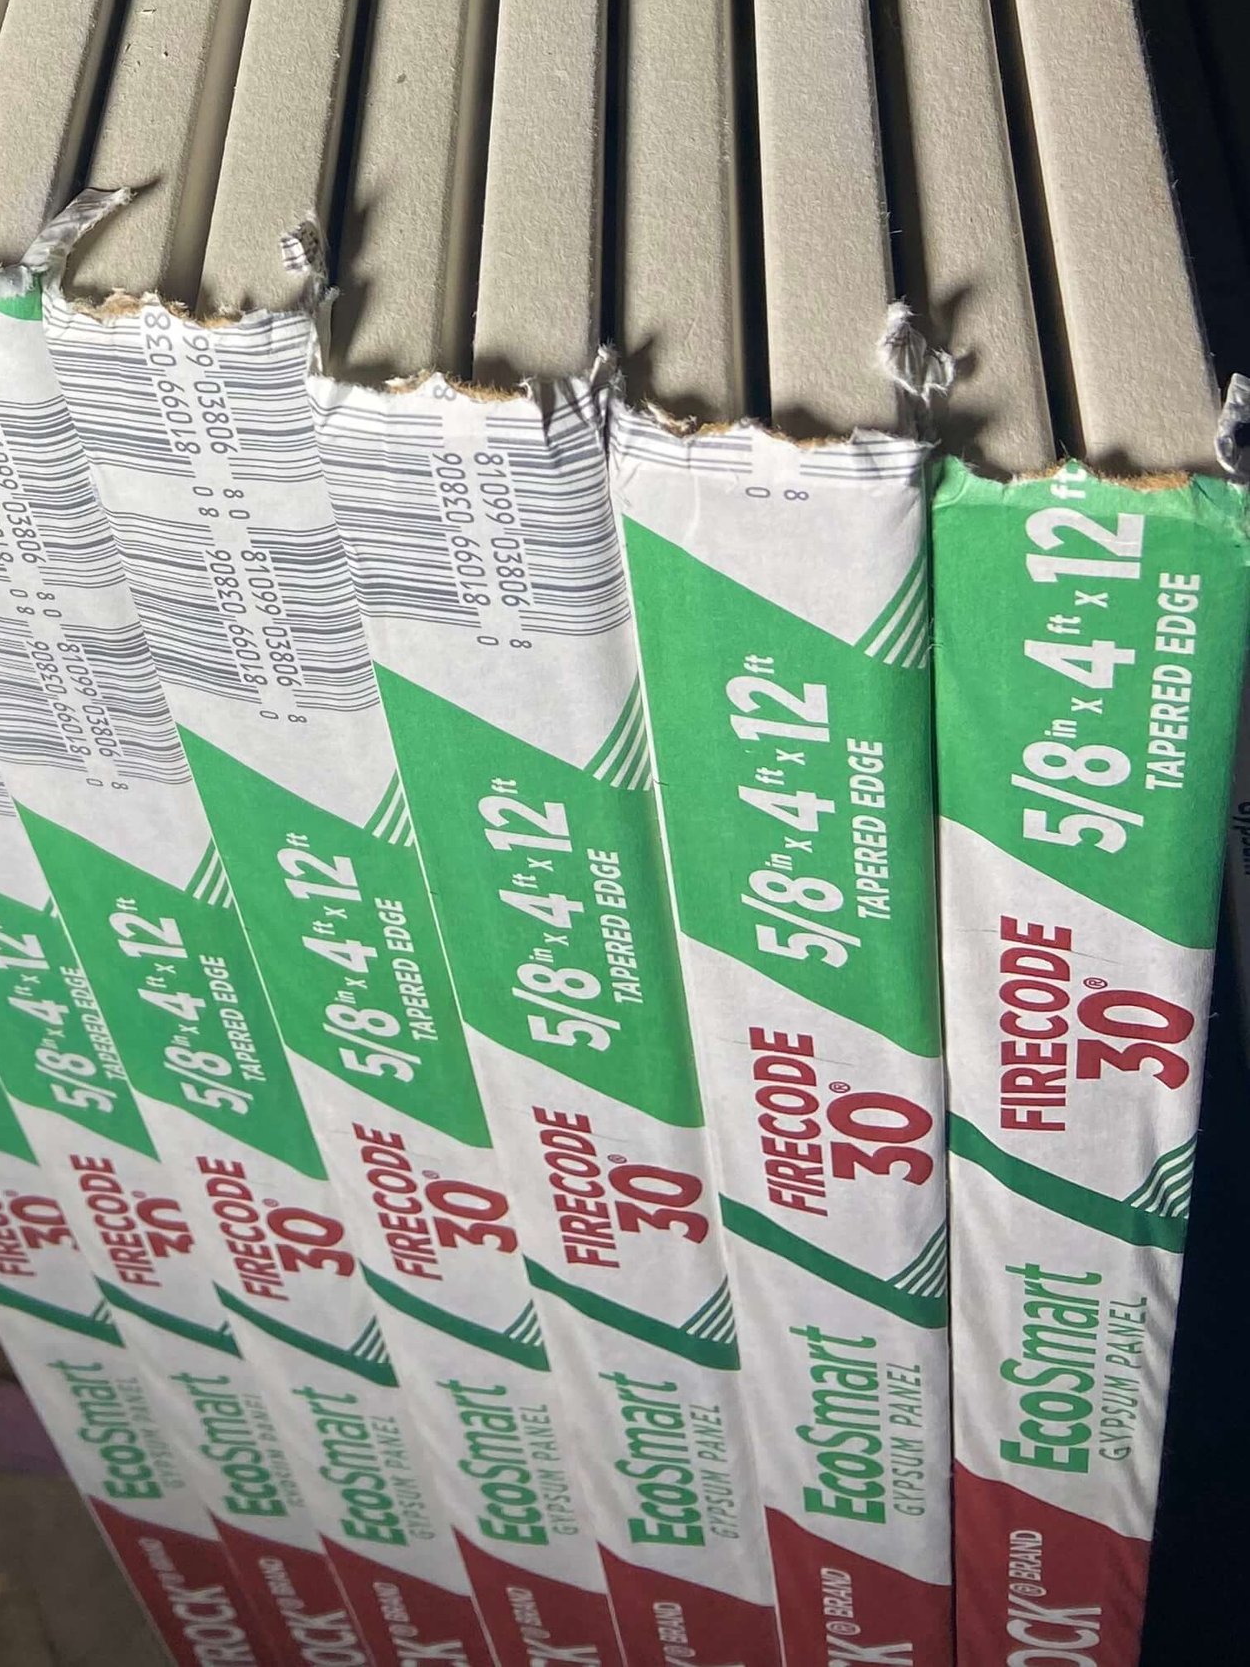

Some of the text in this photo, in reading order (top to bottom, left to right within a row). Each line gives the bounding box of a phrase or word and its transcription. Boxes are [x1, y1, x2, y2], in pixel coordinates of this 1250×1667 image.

[145, 303, 176, 367] 038
[158, 380, 200, 454] 81099
[194, 381, 238, 454] 03806
[2, 502, 47, 563] 03806
[433, 452, 474, 525] 03806
[474, 452, 515, 525] 81099
[206, 550, 246, 615] 03806
[241, 550, 281, 615] 81099
[262, 626, 302, 686] 03806
[451, 536, 491, 606] 81099
[491, 537, 531, 607] 03806
[1075, 590, 1108, 609] x
[26, 641, 67, 694] 03806
[57, 642, 97, 696] 81099
[82, 705, 122, 757] 03806
[228, 624, 267, 685] 81099
[1071, 697, 1103, 715] x
[1145, 572, 1201, 790] TAPERED EDGE
[53, 702, 91, 756] 81099
[776, 748, 805, 765] x
[527, 857, 554, 872] x
[784, 836, 813, 853] x
[846, 738, 891, 919] TAPERED EDGE
[154, 963, 176, 974] x
[323, 906, 347, 919] x
[374, 897, 438, 1041] TAPERED EDGE
[543, 932, 569, 946] x
[587, 848, 643, 1004] TAPERED EDGE
[60, 966, 127, 1080] TAPERED EDGE
[178, 1024, 200, 1034] x
[199, 955, 267, 1081] TAPERED EDGE
[344, 977, 368, 989] x
[999, 915, 1073, 1131] FIRECODE
[748, 1026, 828, 1217] FIRECODE
[70, 1154, 162, 1287] FIRECODE
[196, 1156, 290, 1302] FIRECODE
[351, 1122, 443, 1281] FIRECODE
[532, 1105, 621, 1269] FIRECODE
[789, 1325, 886, 1524] EcoSmart
[1000, 1262, 1102, 1473] EcoSmart
[1099, 1297, 1147, 1461] GYPSUM PANEL
[47, 1359, 163, 1499] EcoSmart
[168, 1372, 288, 1517] EcoSmart
[291, 1386, 408, 1547] EcoSmart
[435, 1379, 550, 1546] EcoSmart
[520, 1404, 579, 1536] GYPSUM PANEL
[598, 1371, 706, 1547] EcoSmart
[689, 1403, 740, 1539] GYPSUM PANEL
[886, 1362, 926, 1517] GYPSUM PANEL
[821, 1567, 854, 1618] BRAND
[1008, 1530, 1043, 1581] BRAND
